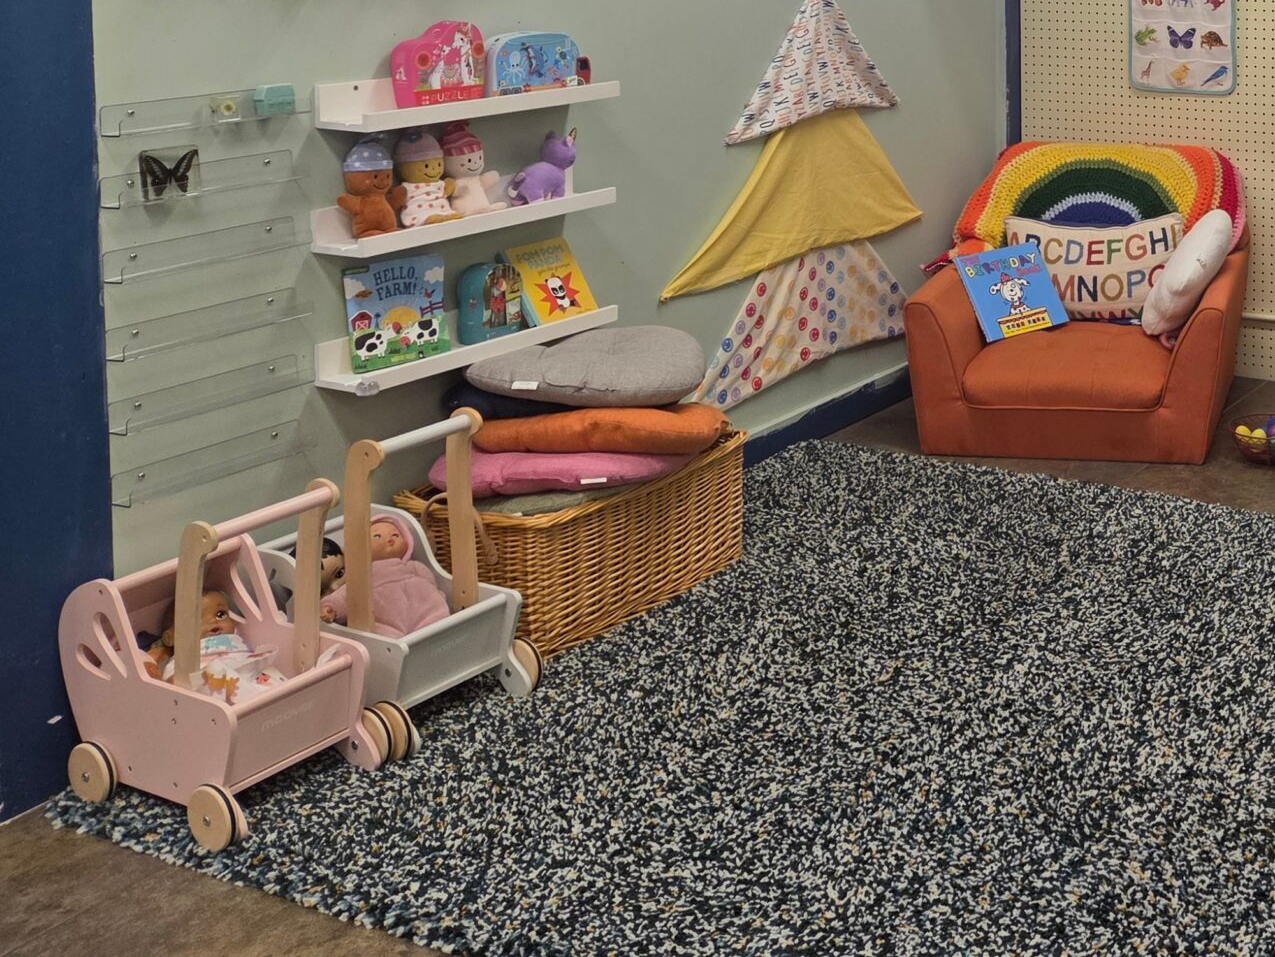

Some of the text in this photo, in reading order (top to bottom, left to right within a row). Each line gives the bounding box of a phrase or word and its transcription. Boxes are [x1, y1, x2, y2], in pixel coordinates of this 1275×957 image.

[965, 252, 1036, 278] BIRTHDAY
[373, 266, 418, 286] HELLO,
[376, 282, 417, 301] FARM!
